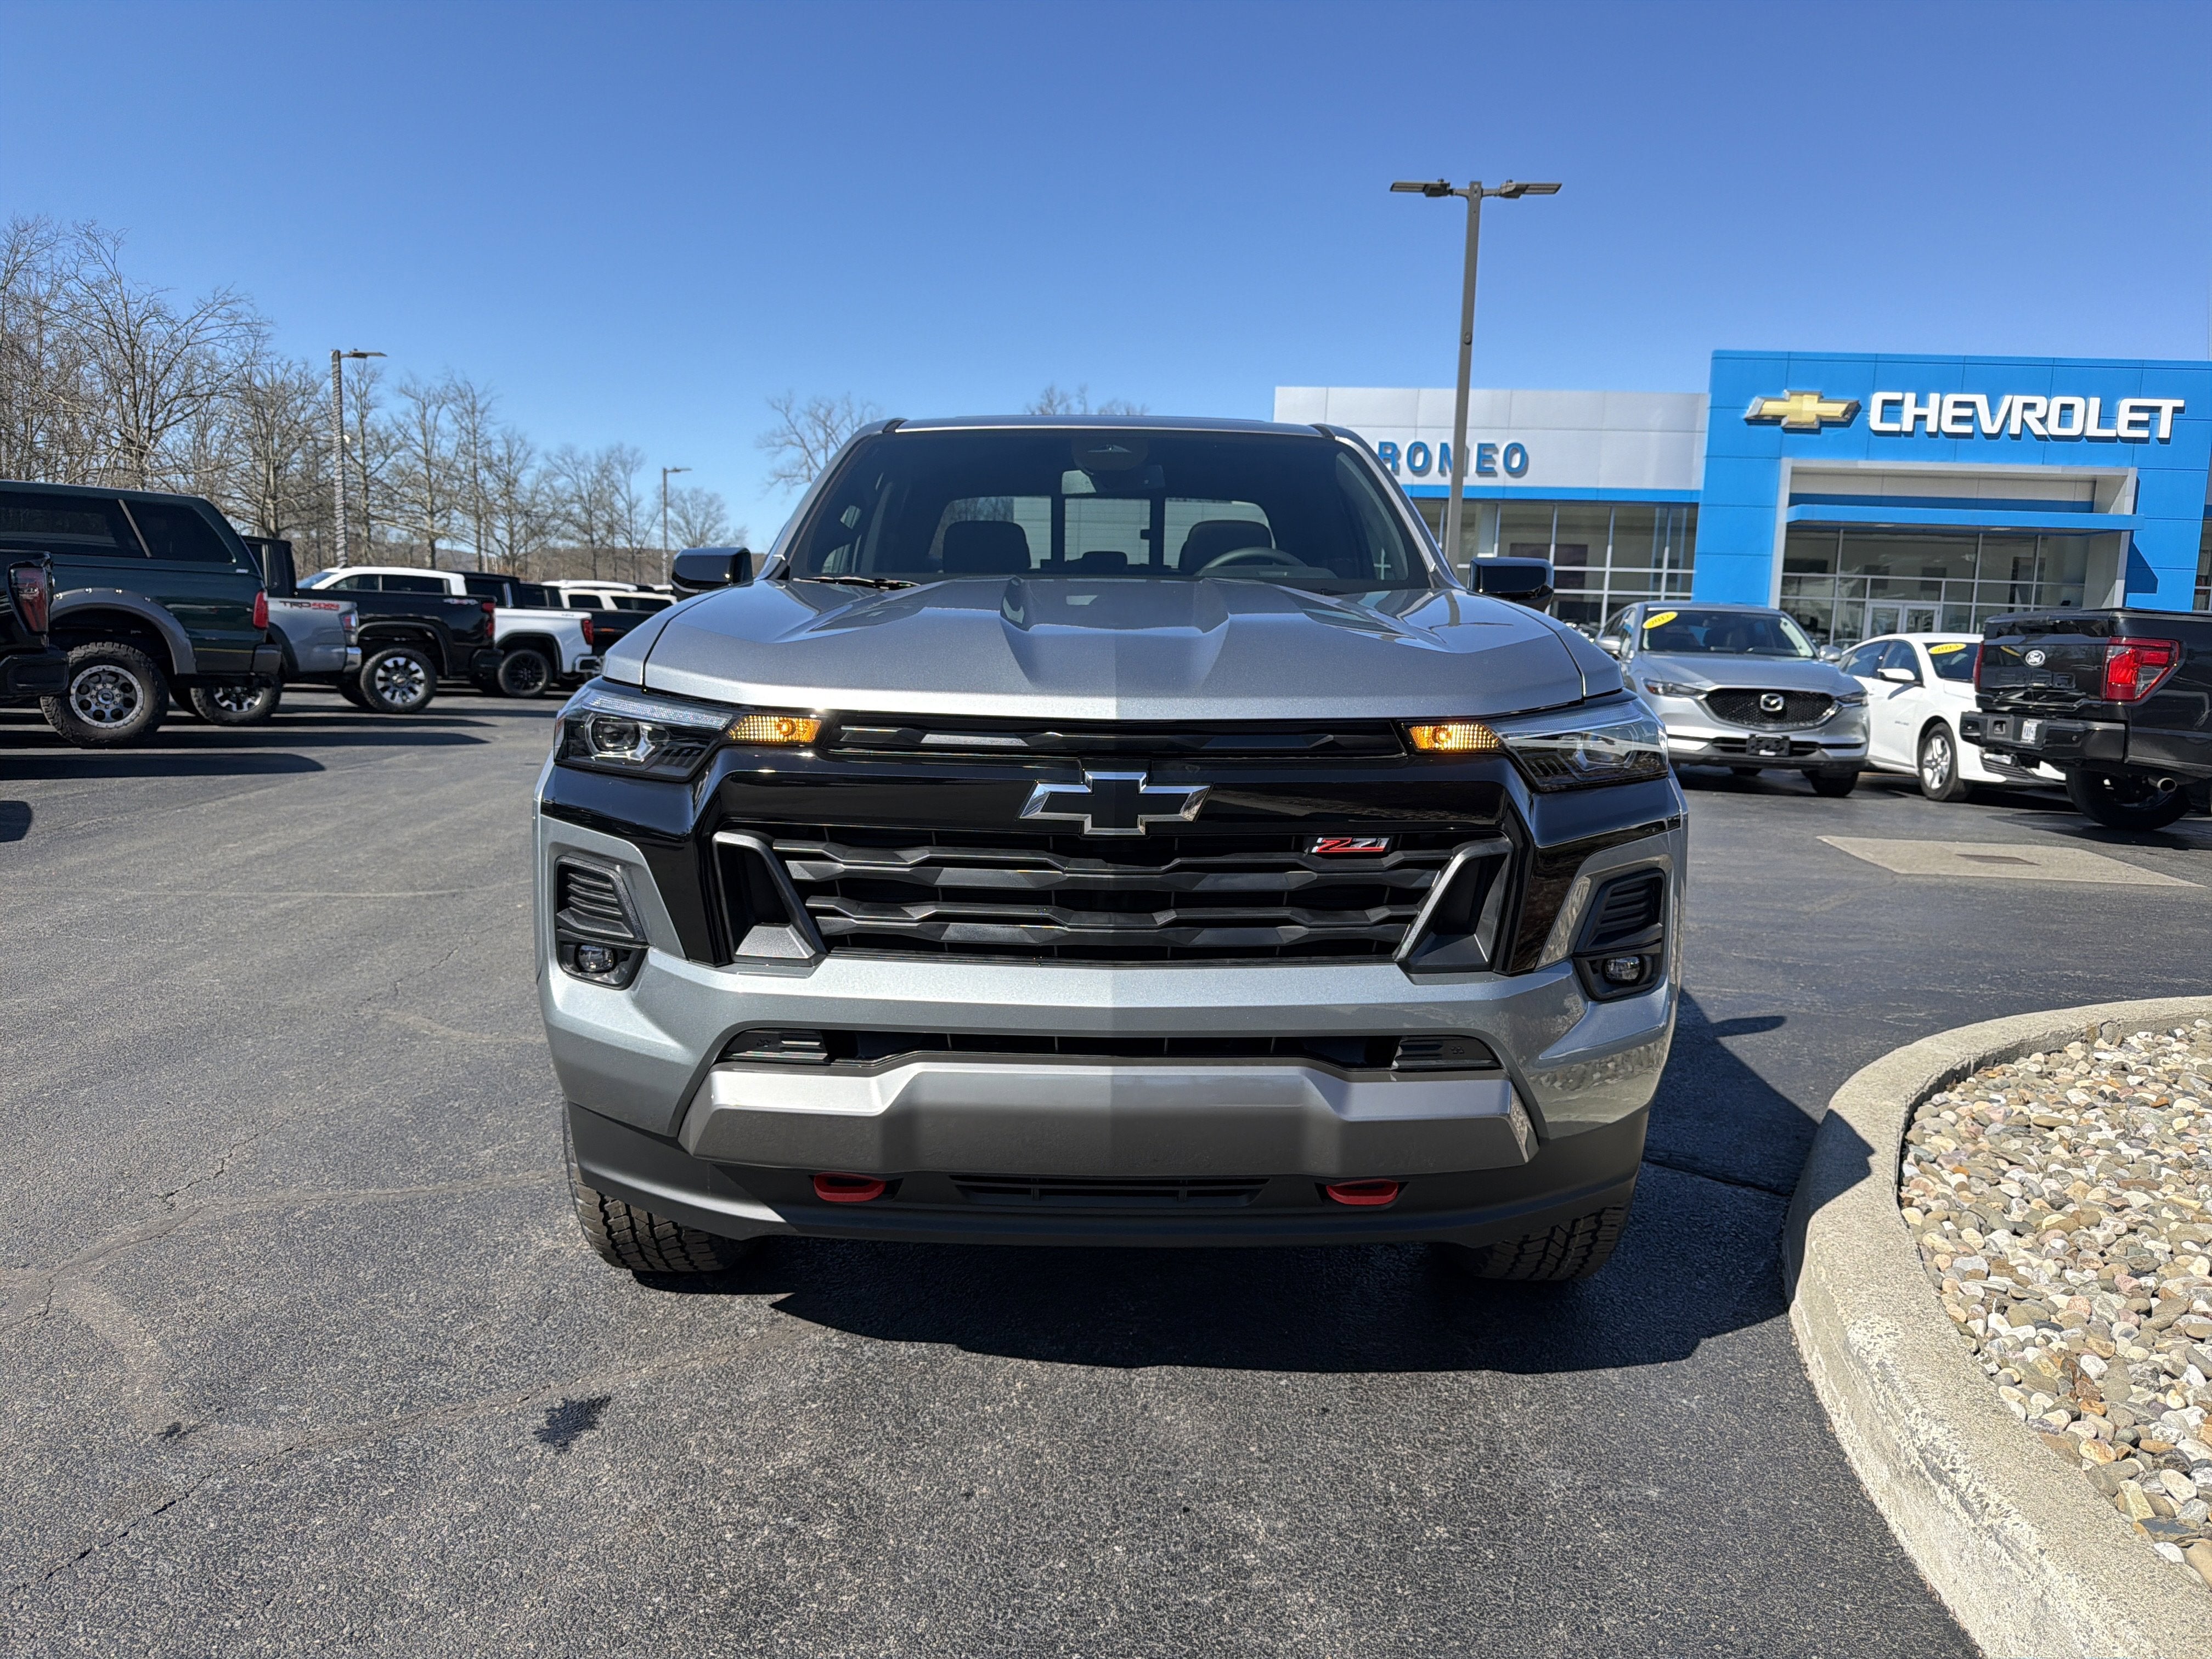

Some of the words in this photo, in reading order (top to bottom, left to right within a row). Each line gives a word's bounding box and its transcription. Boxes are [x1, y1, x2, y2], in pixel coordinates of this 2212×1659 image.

[1869, 392, 2185, 438] CHEVROLET
[1378, 441, 1527, 473] ROMEO
[279, 600, 311, 608] TRD
[1312, 837, 1390, 853] Z71
